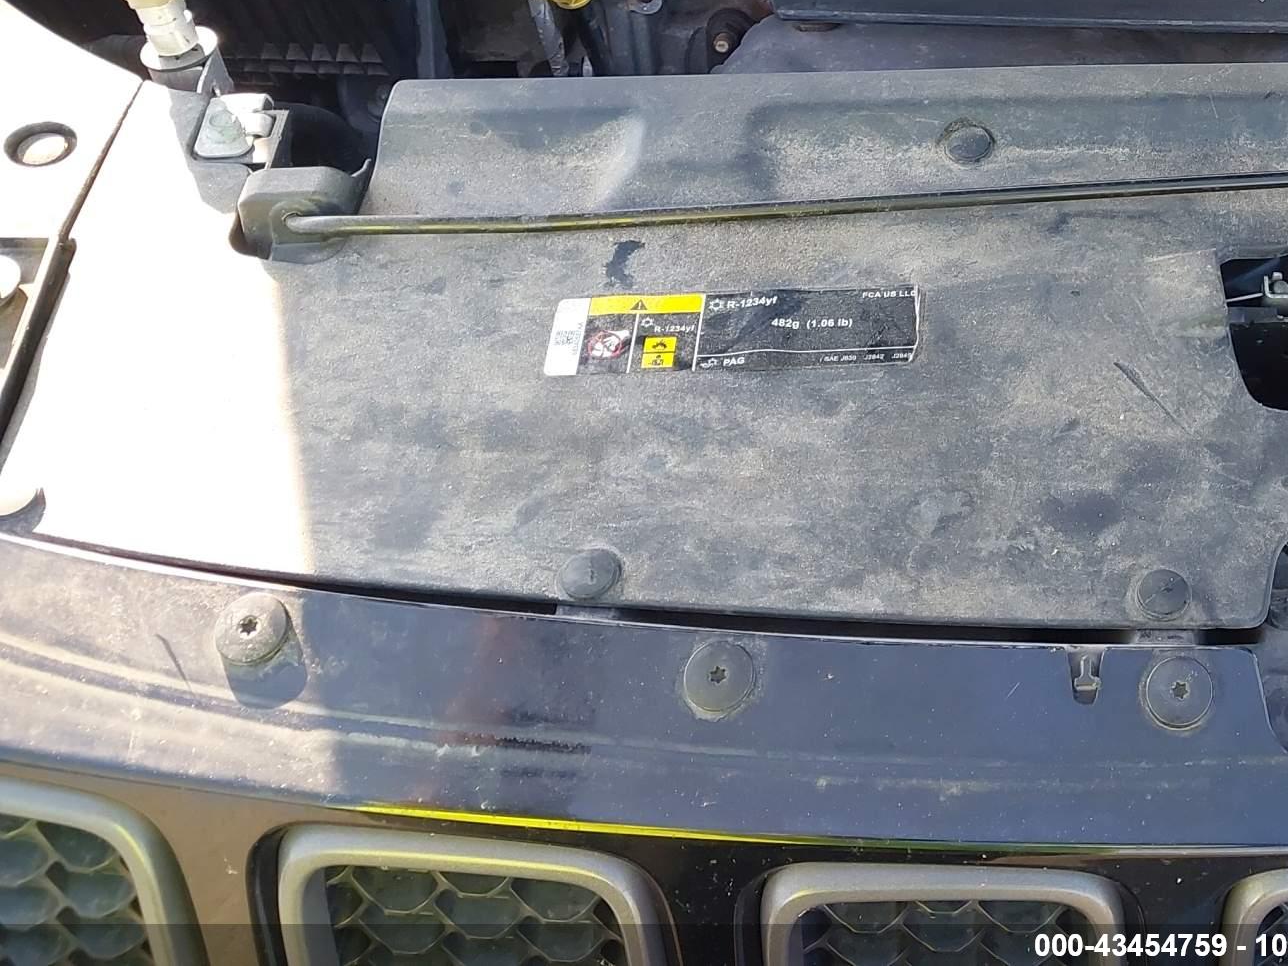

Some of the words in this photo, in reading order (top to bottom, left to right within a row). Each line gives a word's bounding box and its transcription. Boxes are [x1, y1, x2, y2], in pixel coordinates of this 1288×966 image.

[862, 291, 881, 299] FCA
[883, 290, 897, 298] US
[726, 296, 778, 309] R-1234yf
[771, 318, 800, 329] 482g
[806, 318, 834, 329] (1.06
[722, 356, 745, 366] PAG
